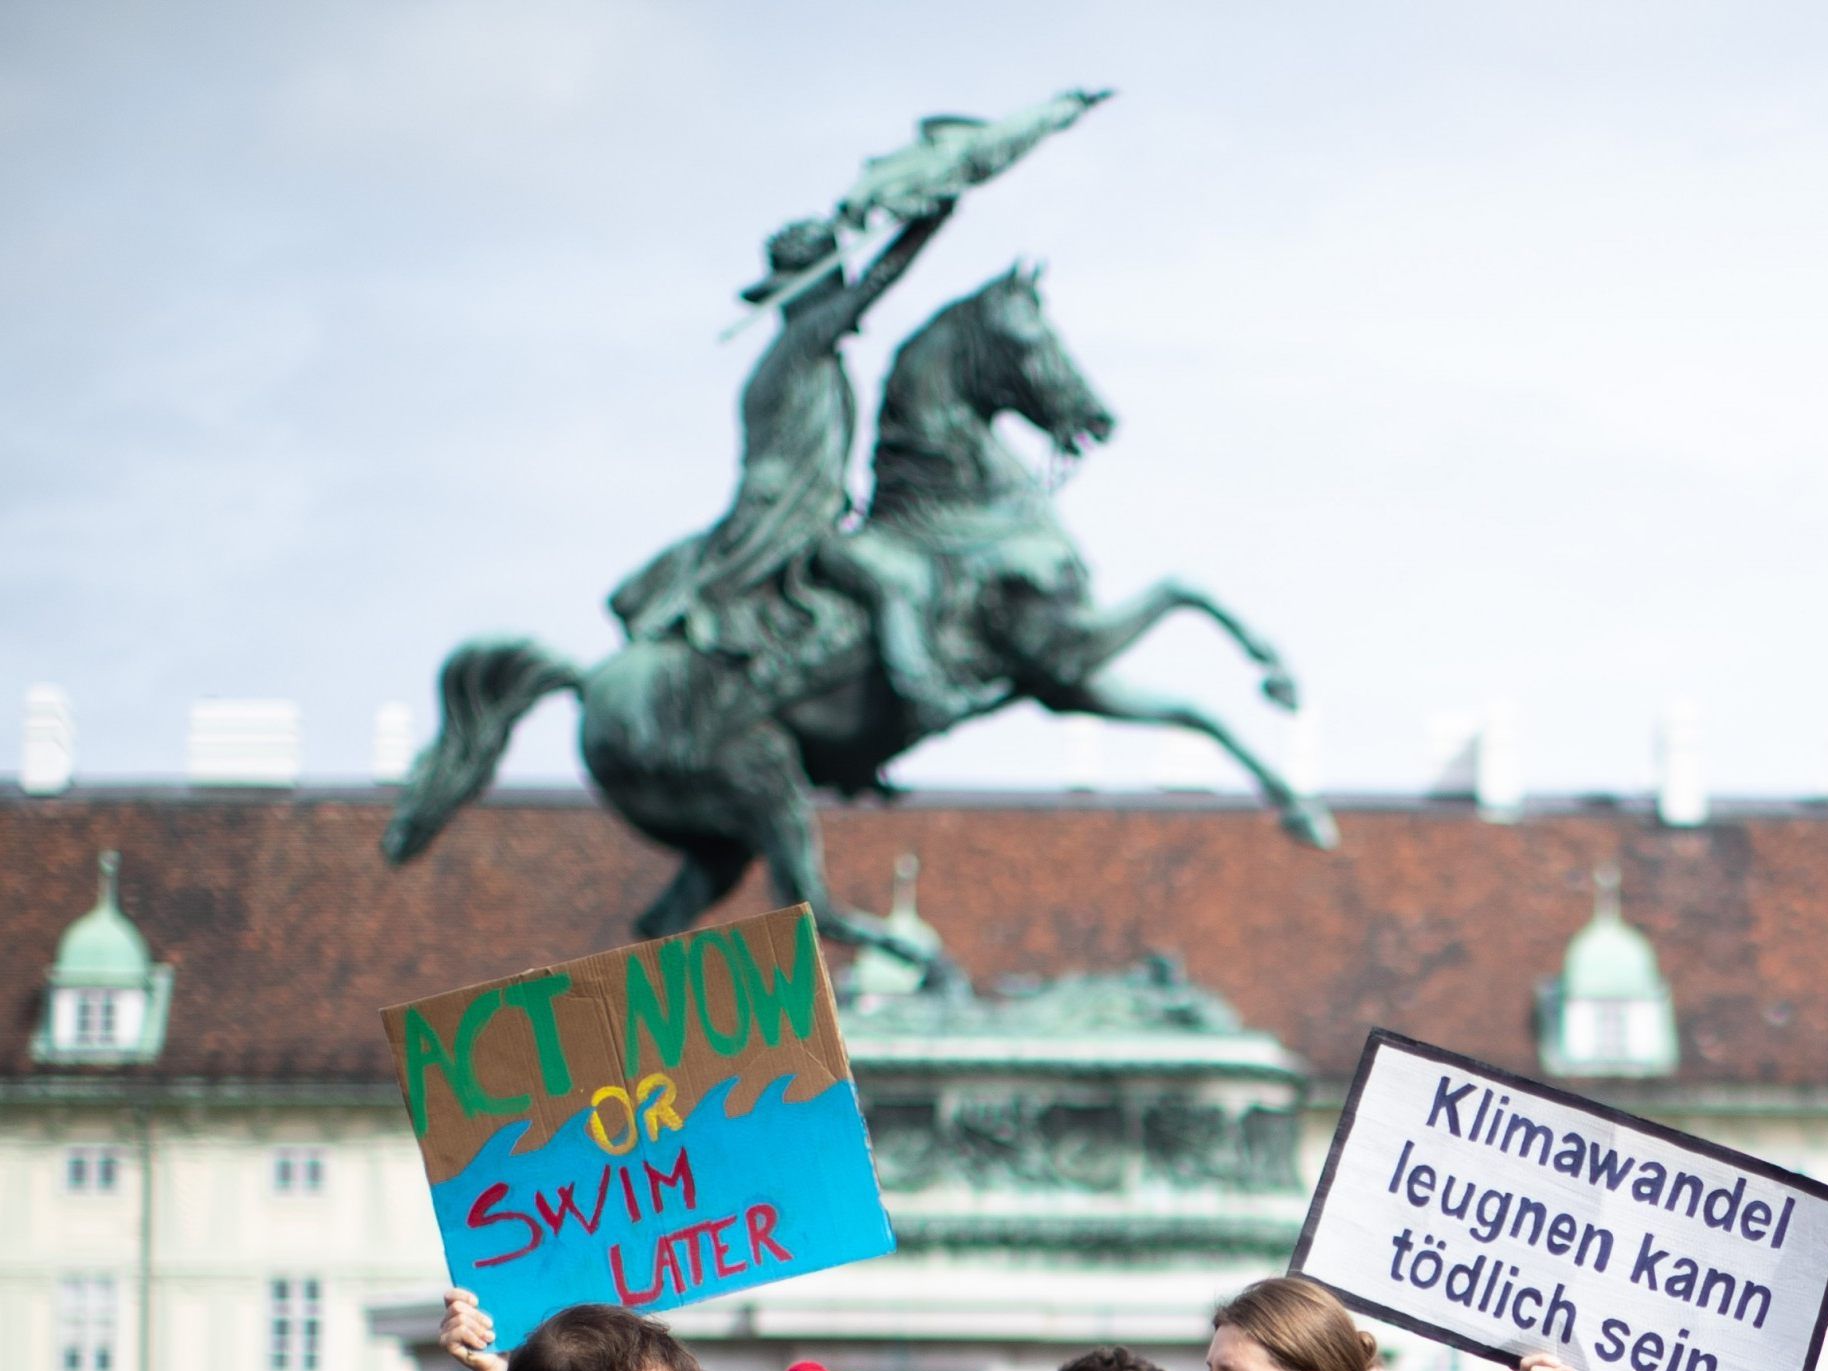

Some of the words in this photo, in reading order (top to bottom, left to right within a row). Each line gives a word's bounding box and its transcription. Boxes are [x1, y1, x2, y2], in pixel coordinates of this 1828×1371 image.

[405, 972, 573, 1140] ACT
[625, 912, 819, 1079] NOW
[590, 1073, 684, 1155] OR
[1426, 1075, 1797, 1250] Klimawandel
[467, 1146, 697, 1269] SWIM
[608, 1203, 795, 1308] LATER
[1388, 1140, 1615, 1273] leugnen
[1630, 1233, 1773, 1330] kann
[1390, 1228, 1578, 1345] tödlich
